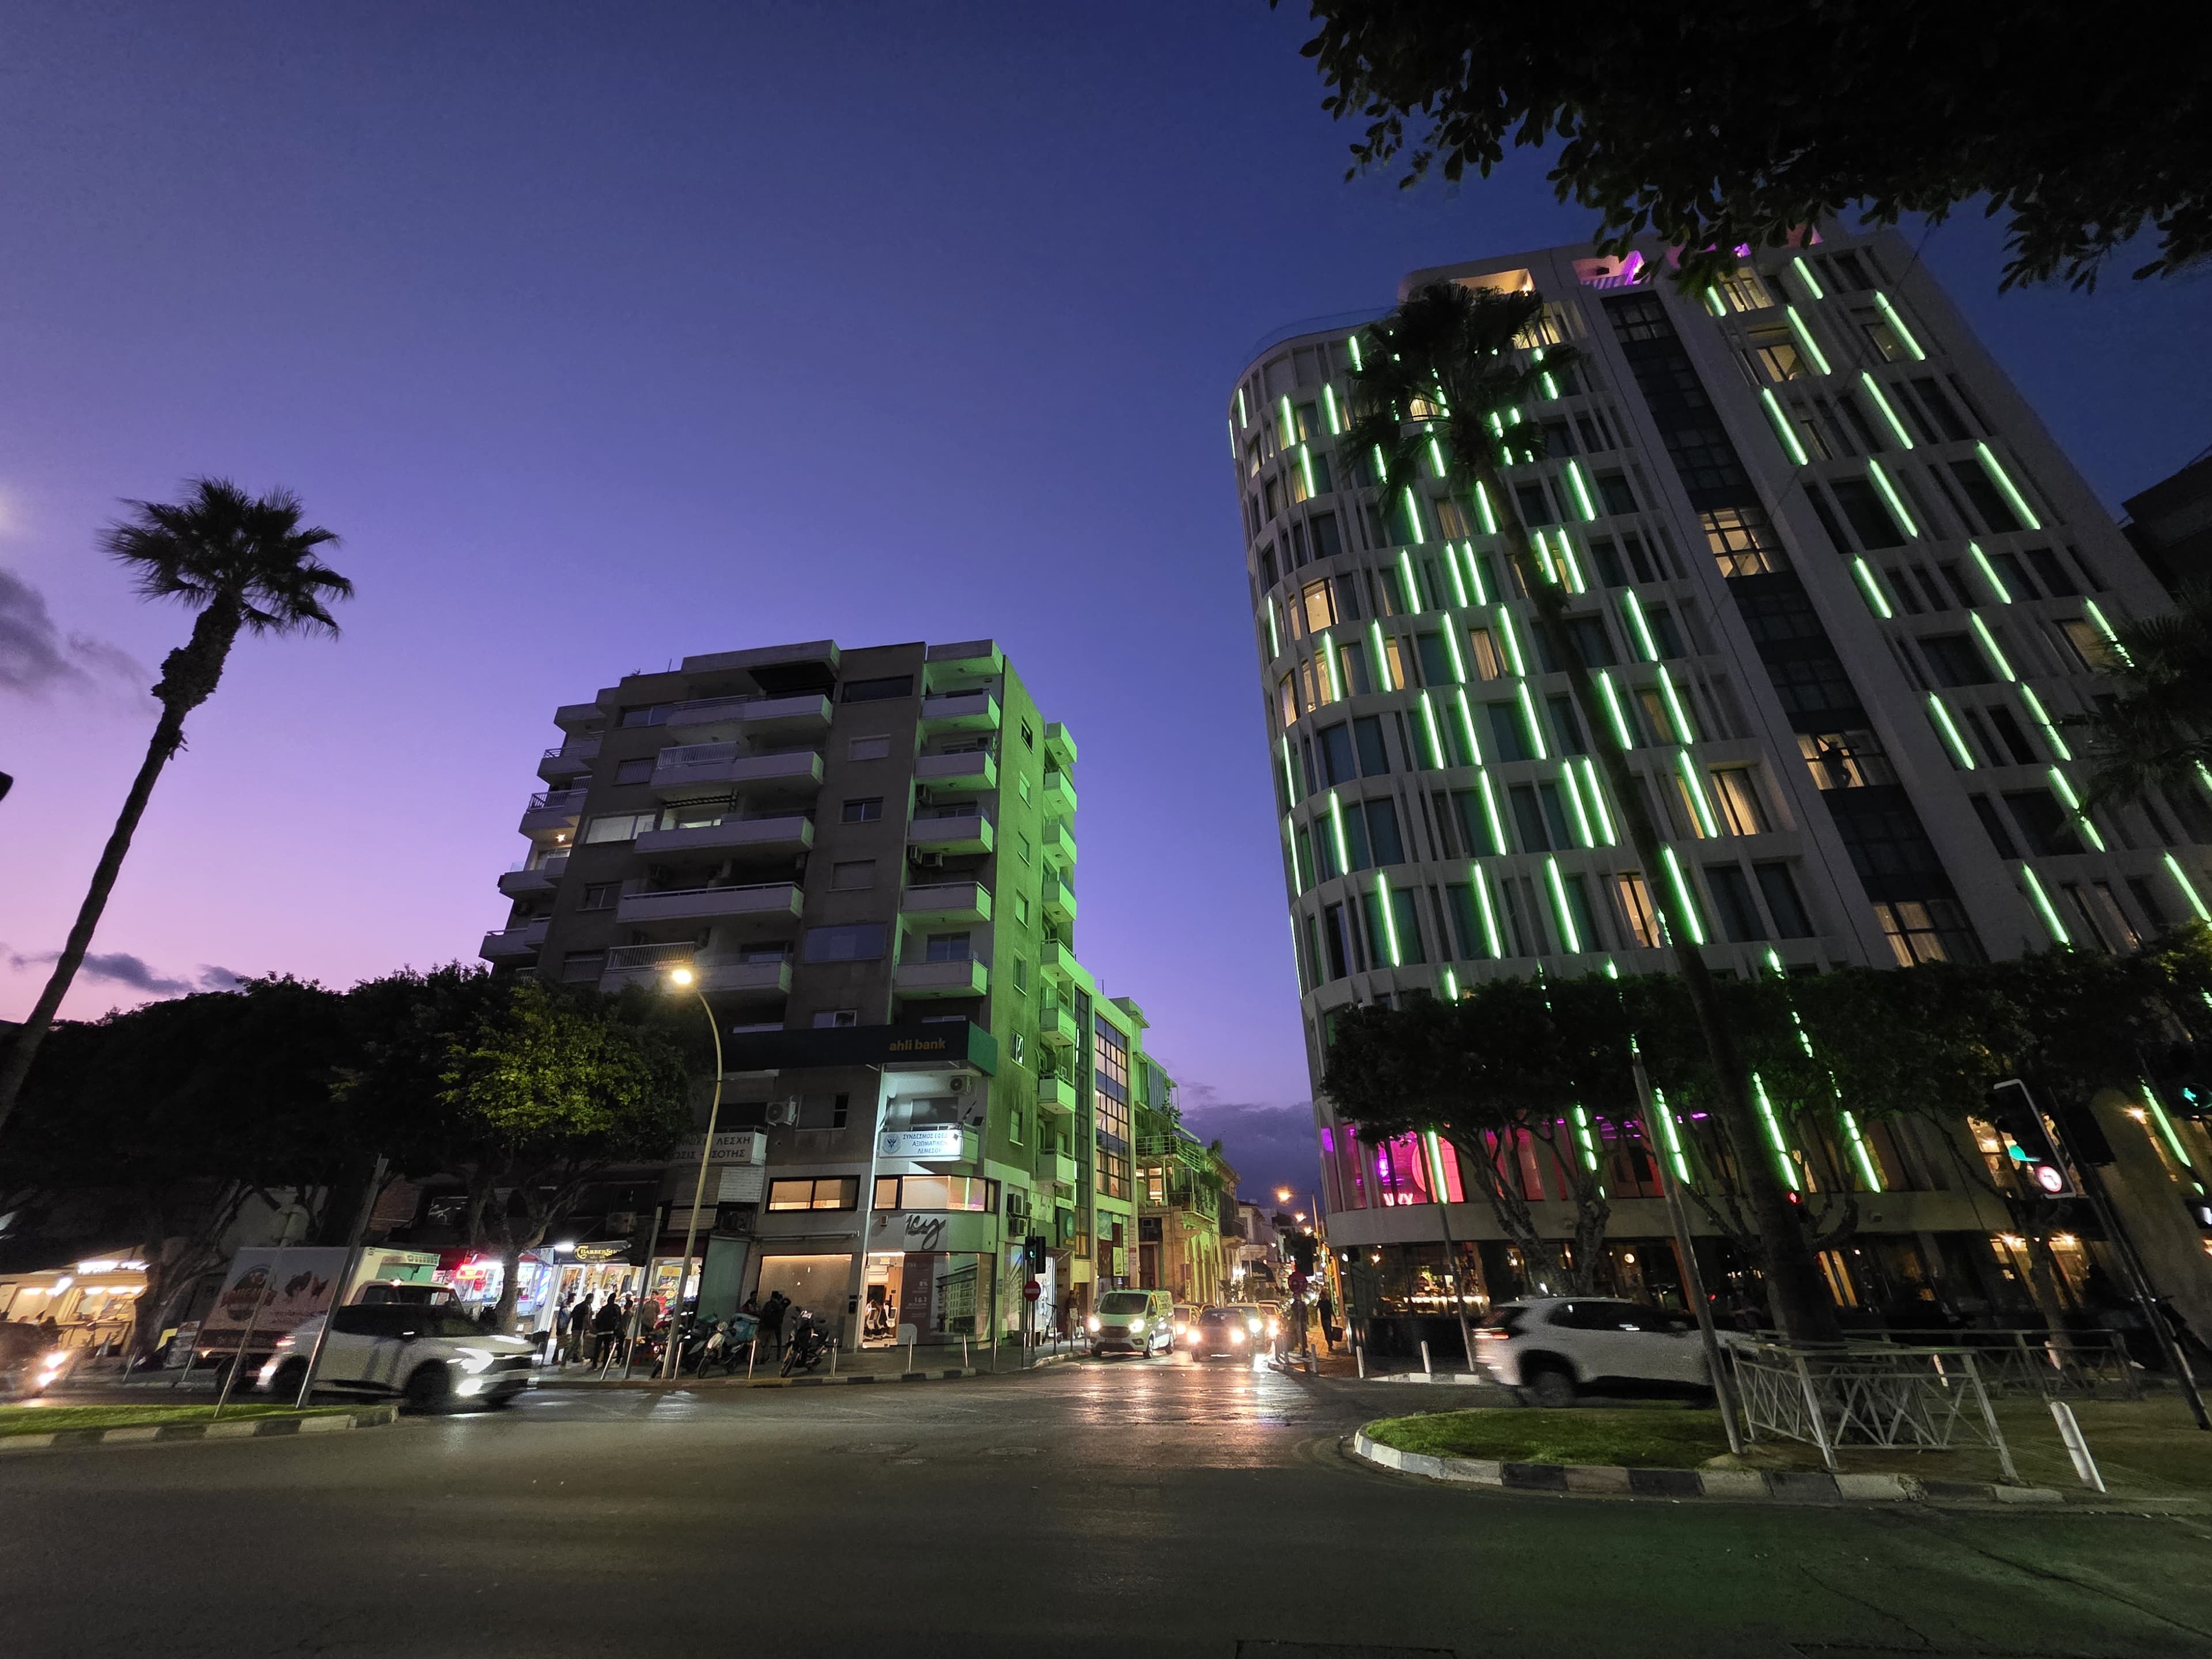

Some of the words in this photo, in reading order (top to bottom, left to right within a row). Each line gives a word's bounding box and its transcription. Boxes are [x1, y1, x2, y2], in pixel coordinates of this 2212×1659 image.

[889, 1039, 912, 1051] ahli
[915, 1037, 946, 1050] bank
[716, 1135, 751, 1145] ΛΕΣΧΗ
